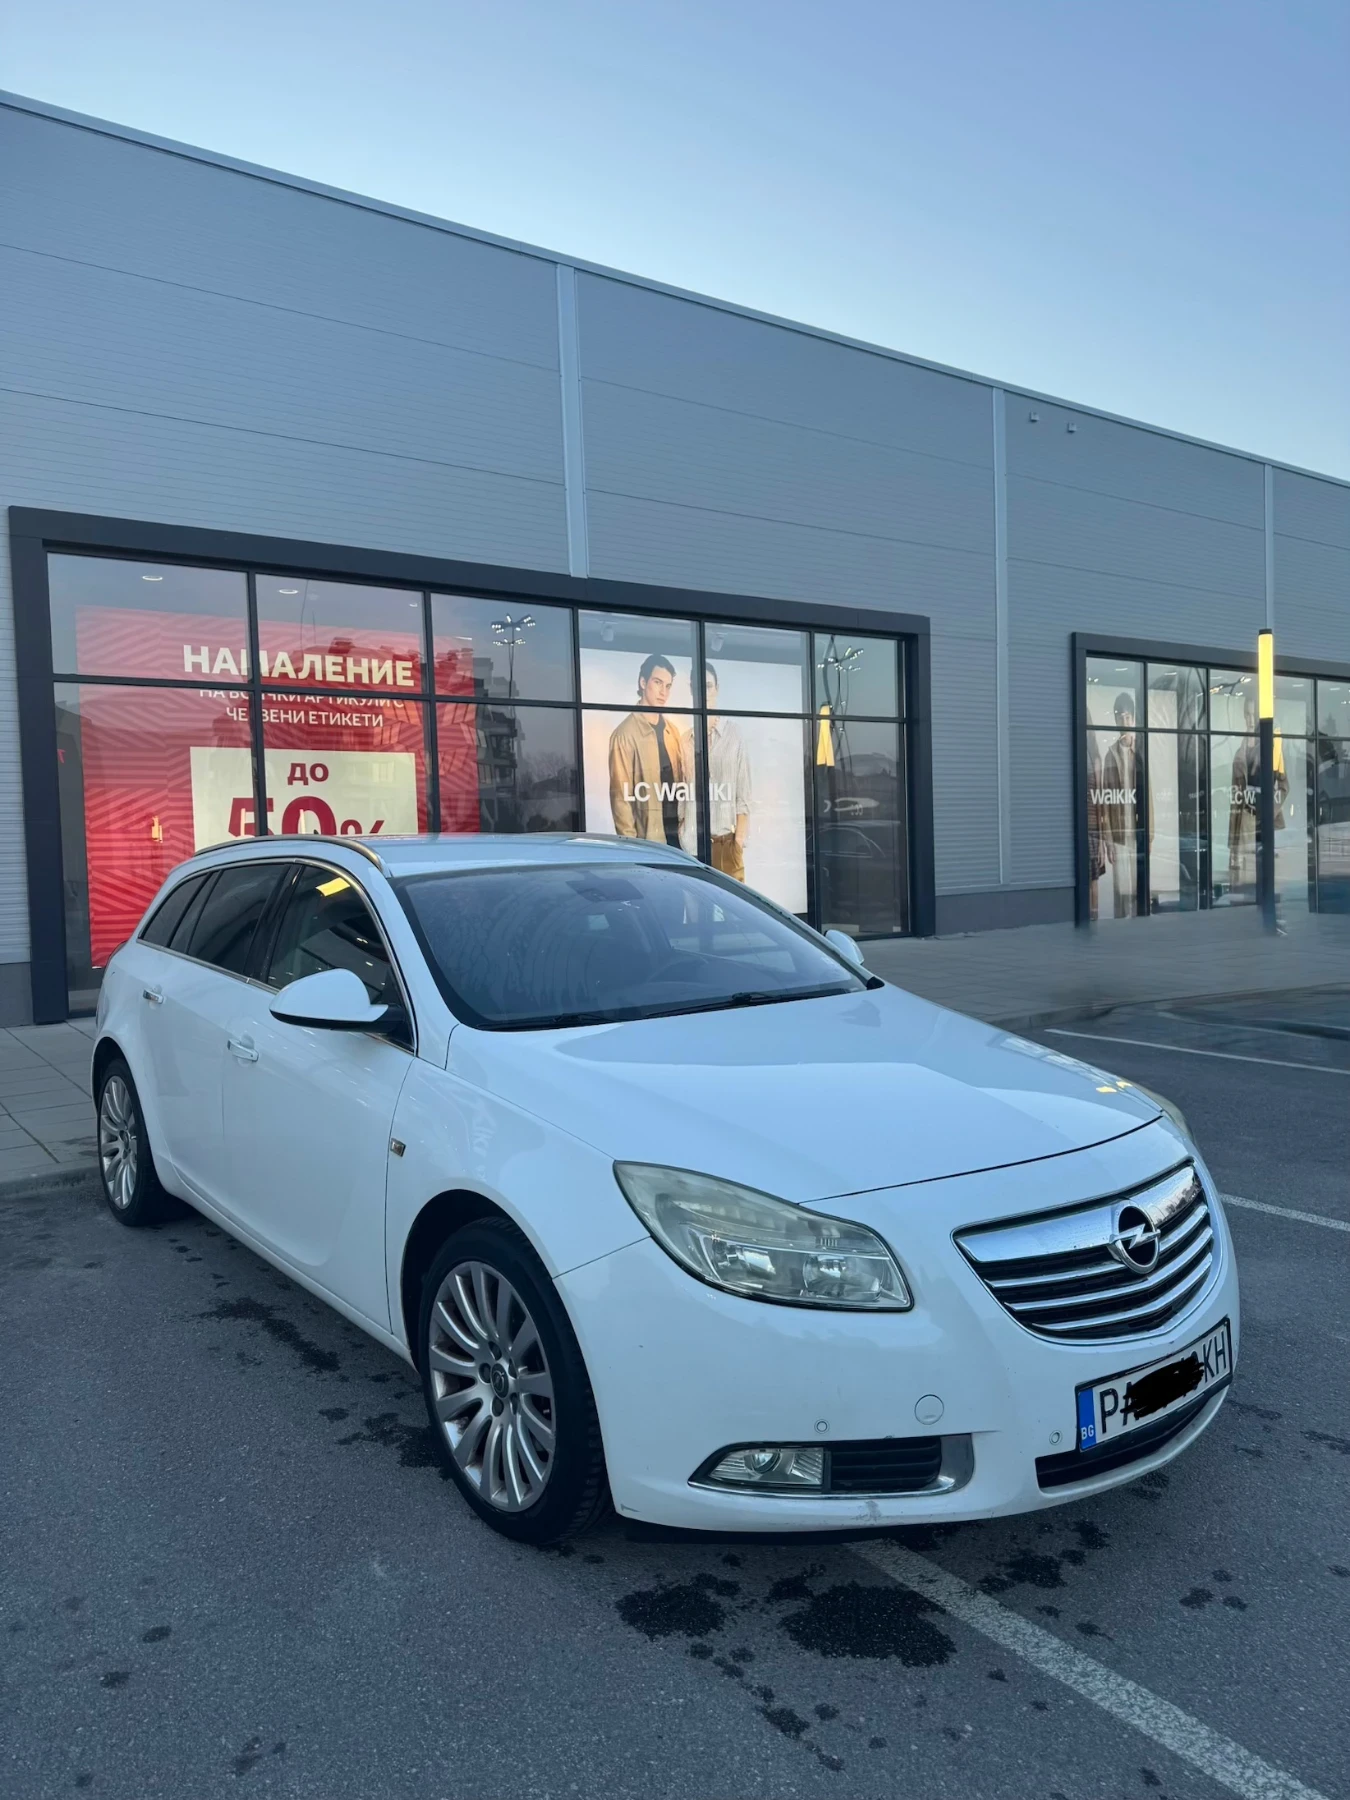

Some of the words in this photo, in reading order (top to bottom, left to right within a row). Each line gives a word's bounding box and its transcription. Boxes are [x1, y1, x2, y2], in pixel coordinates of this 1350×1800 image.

[226, 706, 305, 724] ЧЕВЕНИ
[308, 711, 384, 728] ЕТИКЕТИ
[623, 781, 651, 802] LC
[1202, 1330, 1227, 1383] KH
[1080, 1424, 1095, 1441] BG
